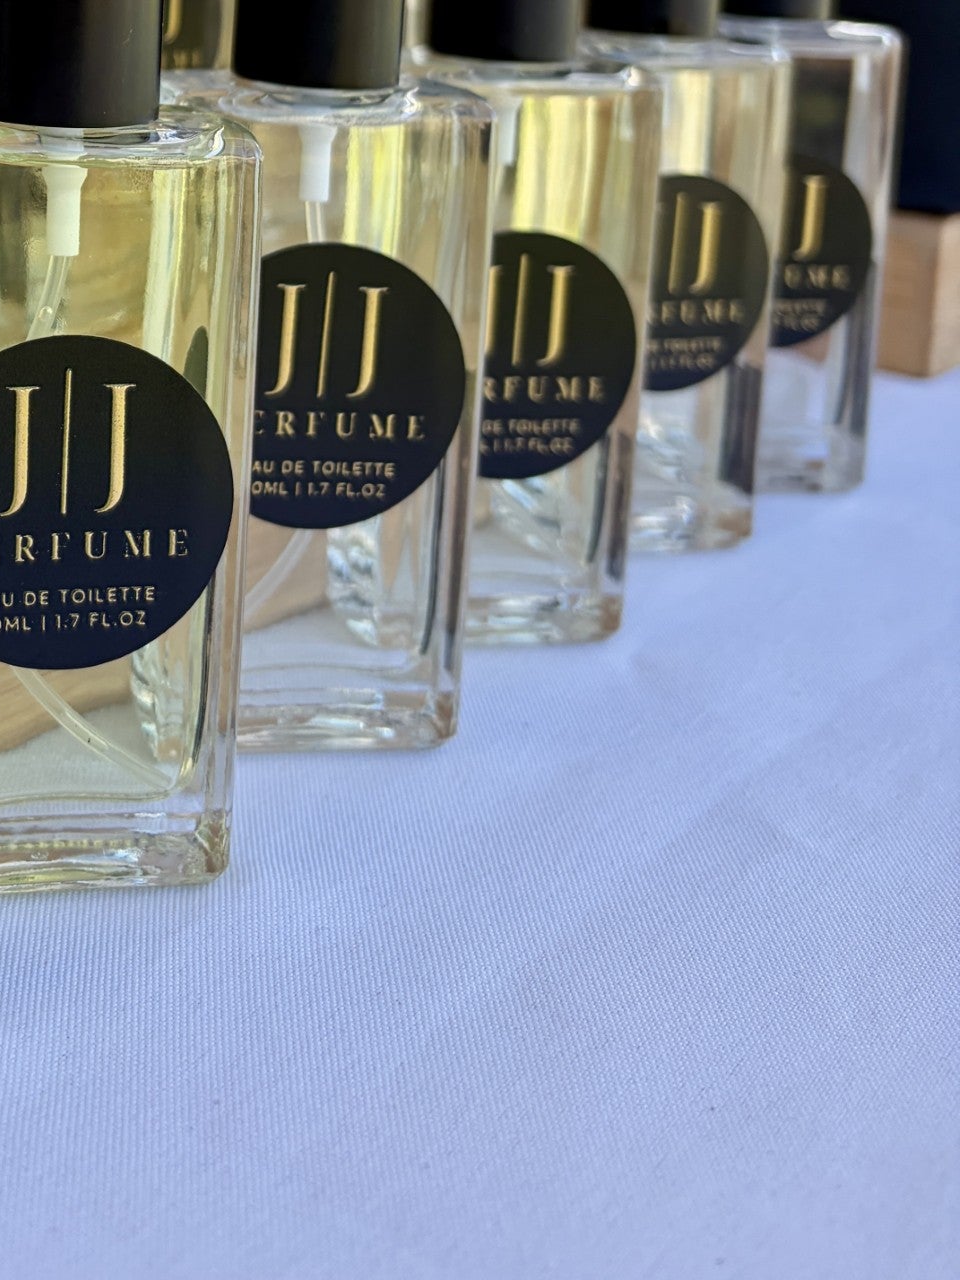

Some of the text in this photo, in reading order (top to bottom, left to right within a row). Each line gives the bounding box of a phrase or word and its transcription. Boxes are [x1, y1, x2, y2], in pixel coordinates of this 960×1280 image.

[483, 376, 606, 403] RFUME
[255, 410, 426, 440] RFUME
[252, 460, 395, 478] AU DE TOILETTE
[251, 481, 288, 495] 0ML
[308, 482, 330, 496] 1.7
[25, 591, 49, 607] DE
[60, 586, 156, 604] TOILETTE
[55, 613, 79, 629] 1.7
